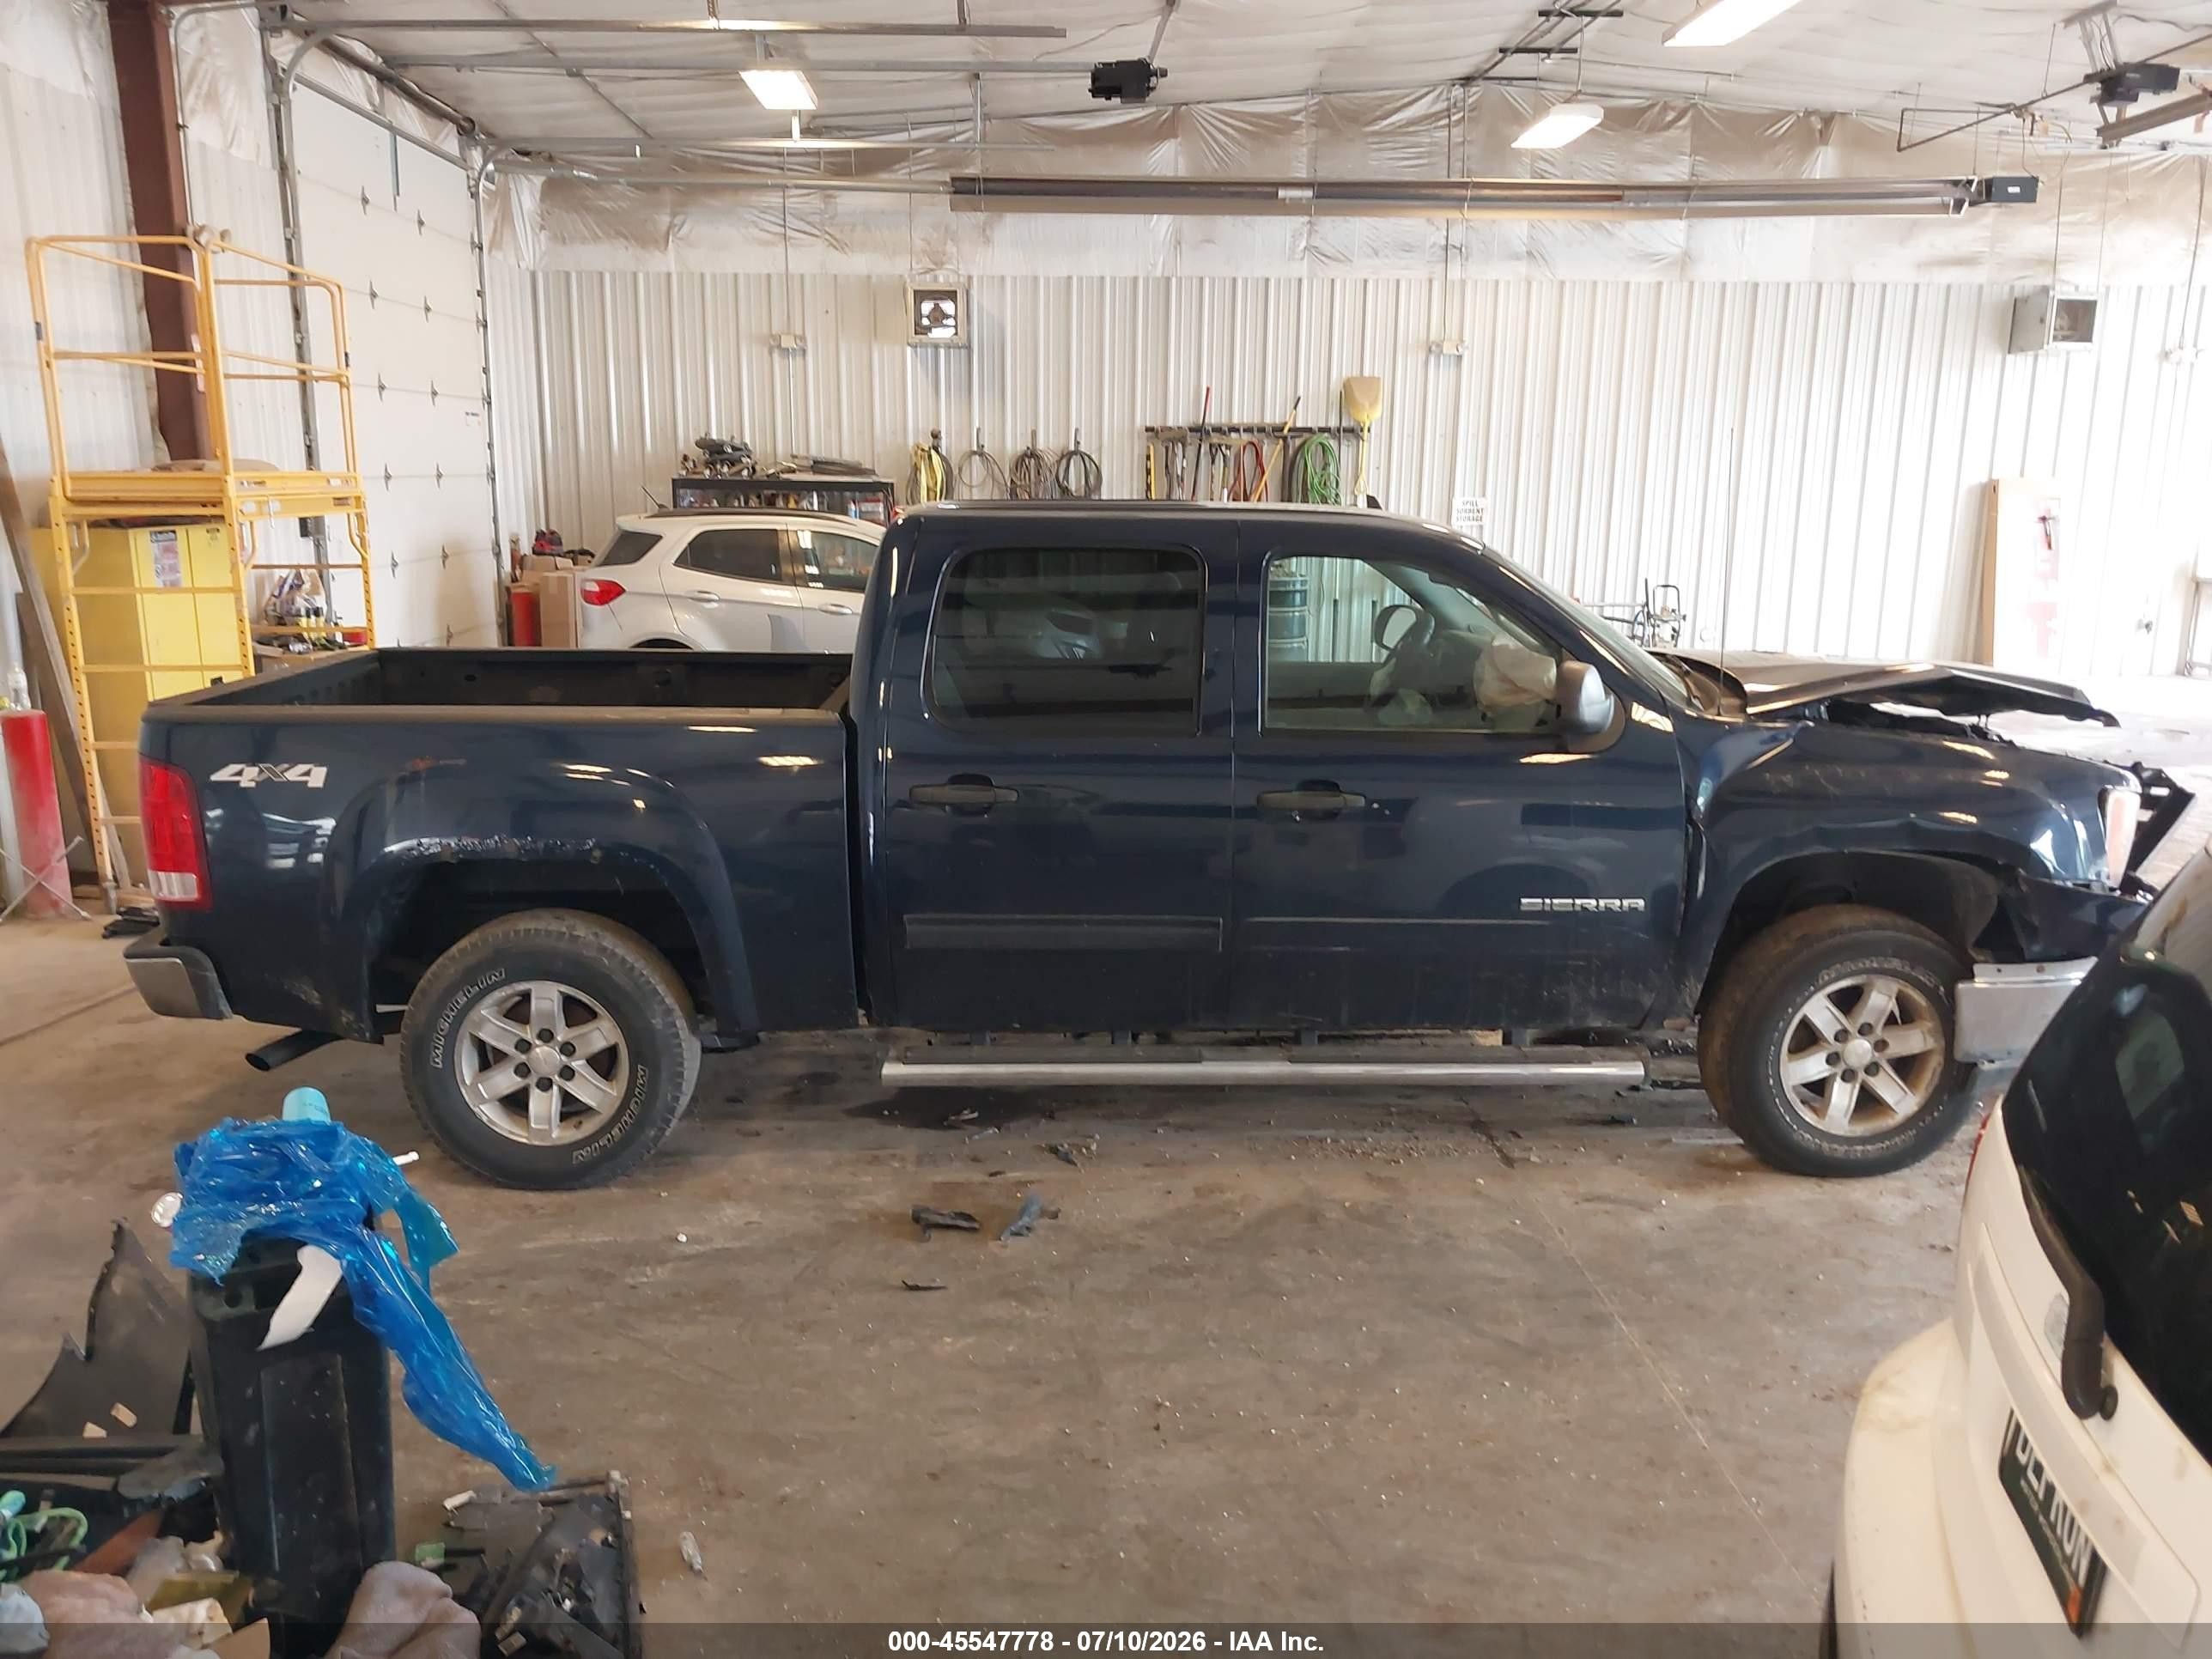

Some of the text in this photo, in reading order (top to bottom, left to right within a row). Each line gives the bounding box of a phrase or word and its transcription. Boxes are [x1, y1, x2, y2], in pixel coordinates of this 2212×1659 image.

[1520, 897, 1645, 912] SIERRA
[430, 968, 506, 1069] MICHELIN
[572, 1064, 649, 1164] MICHELIN
